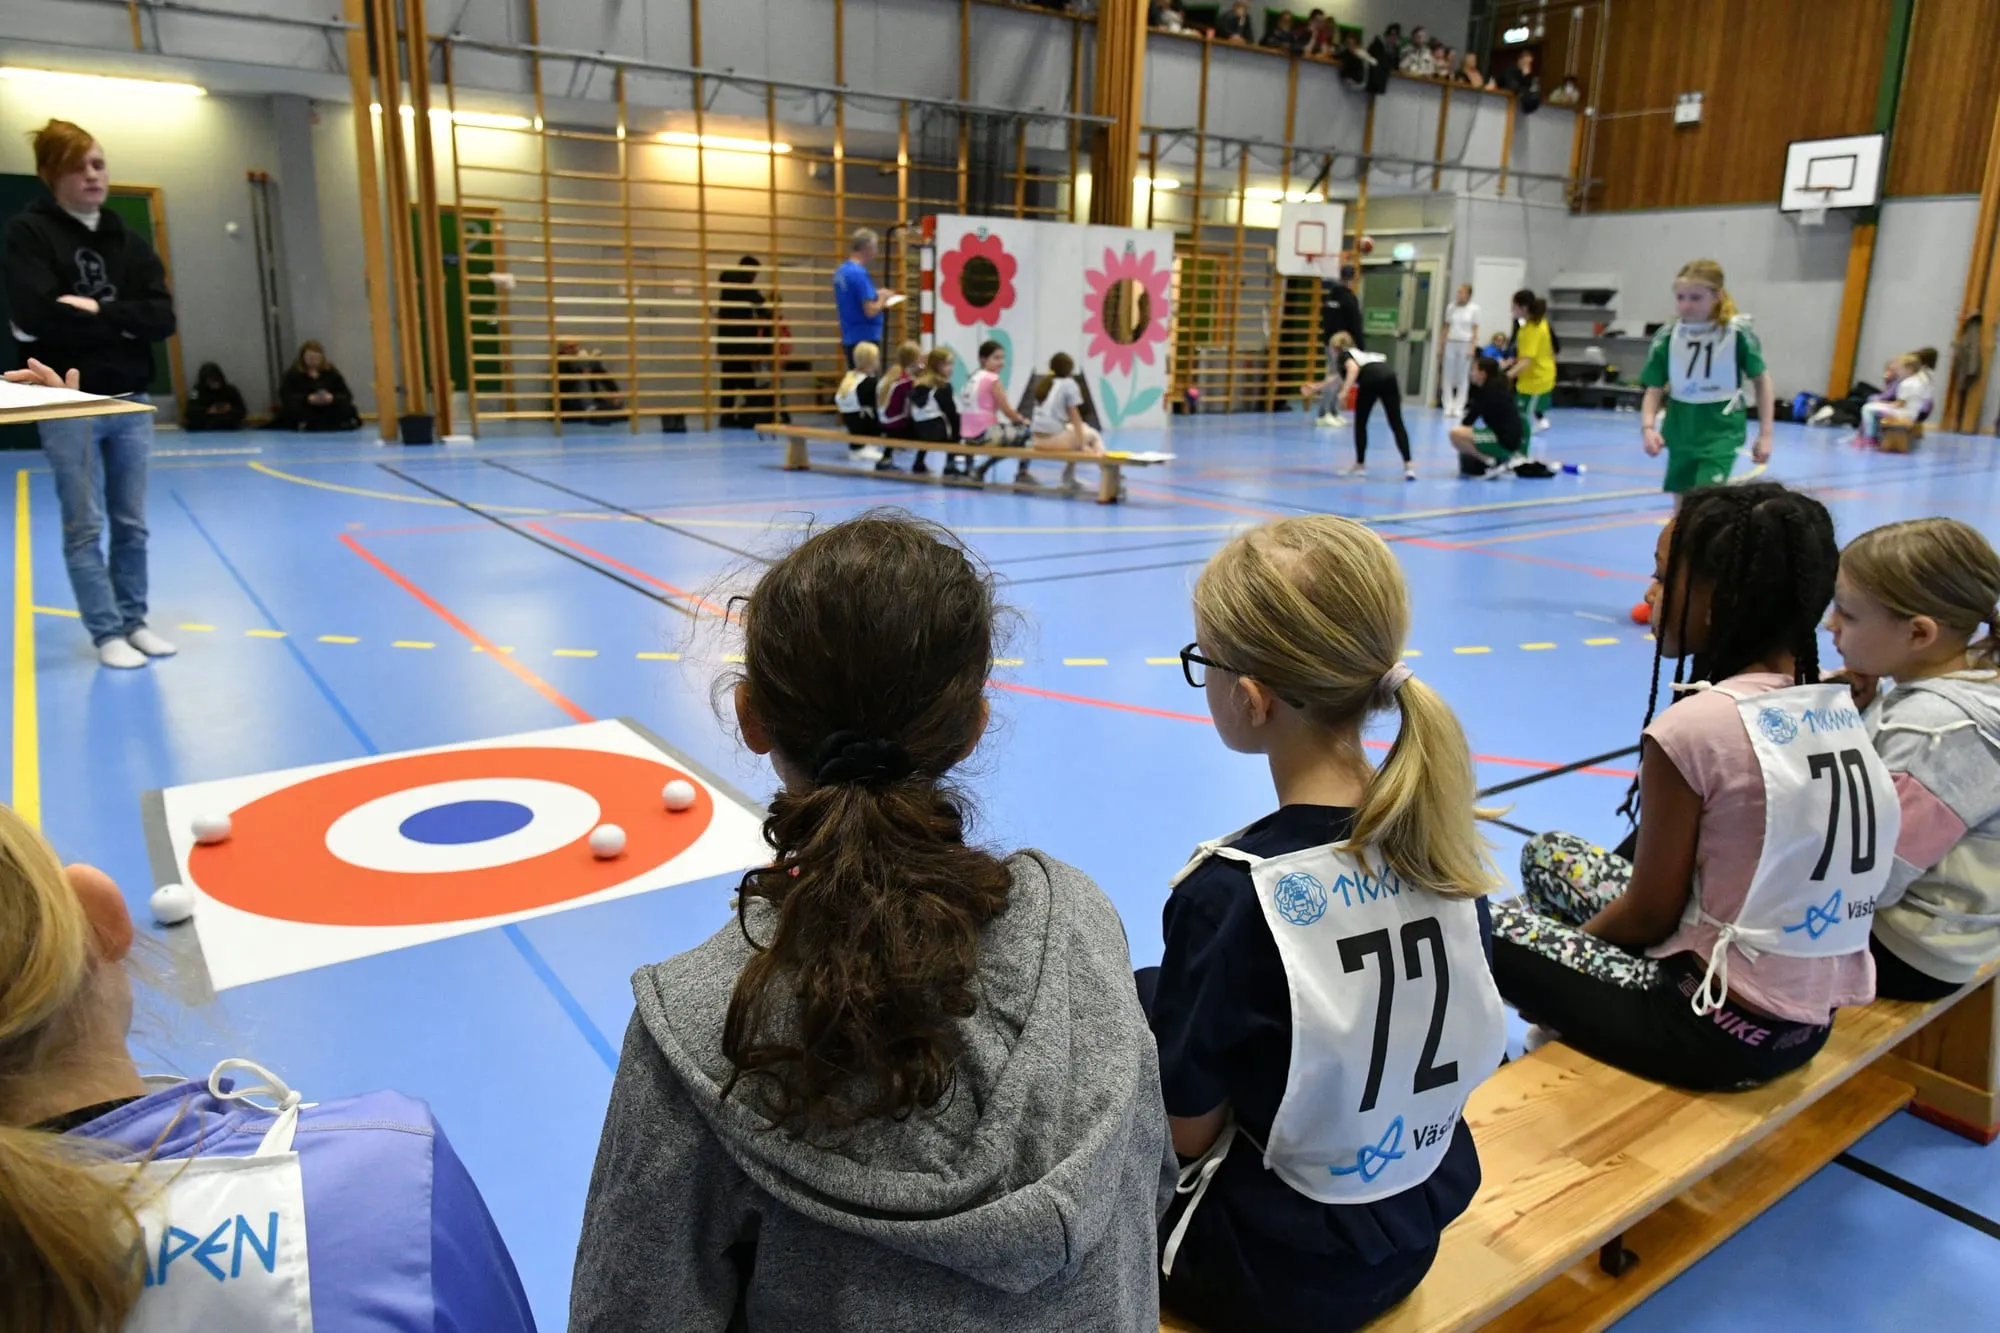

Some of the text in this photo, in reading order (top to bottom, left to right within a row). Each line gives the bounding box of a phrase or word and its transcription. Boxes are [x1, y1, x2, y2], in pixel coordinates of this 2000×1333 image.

[1686, 341, 1713, 379] 71
[1808, 749, 1876, 881] 70
[1337, 917, 1458, 1113] 72
[1704, 1006, 1771, 1046] NIKE
[1413, 1113, 1454, 1150] Väs
